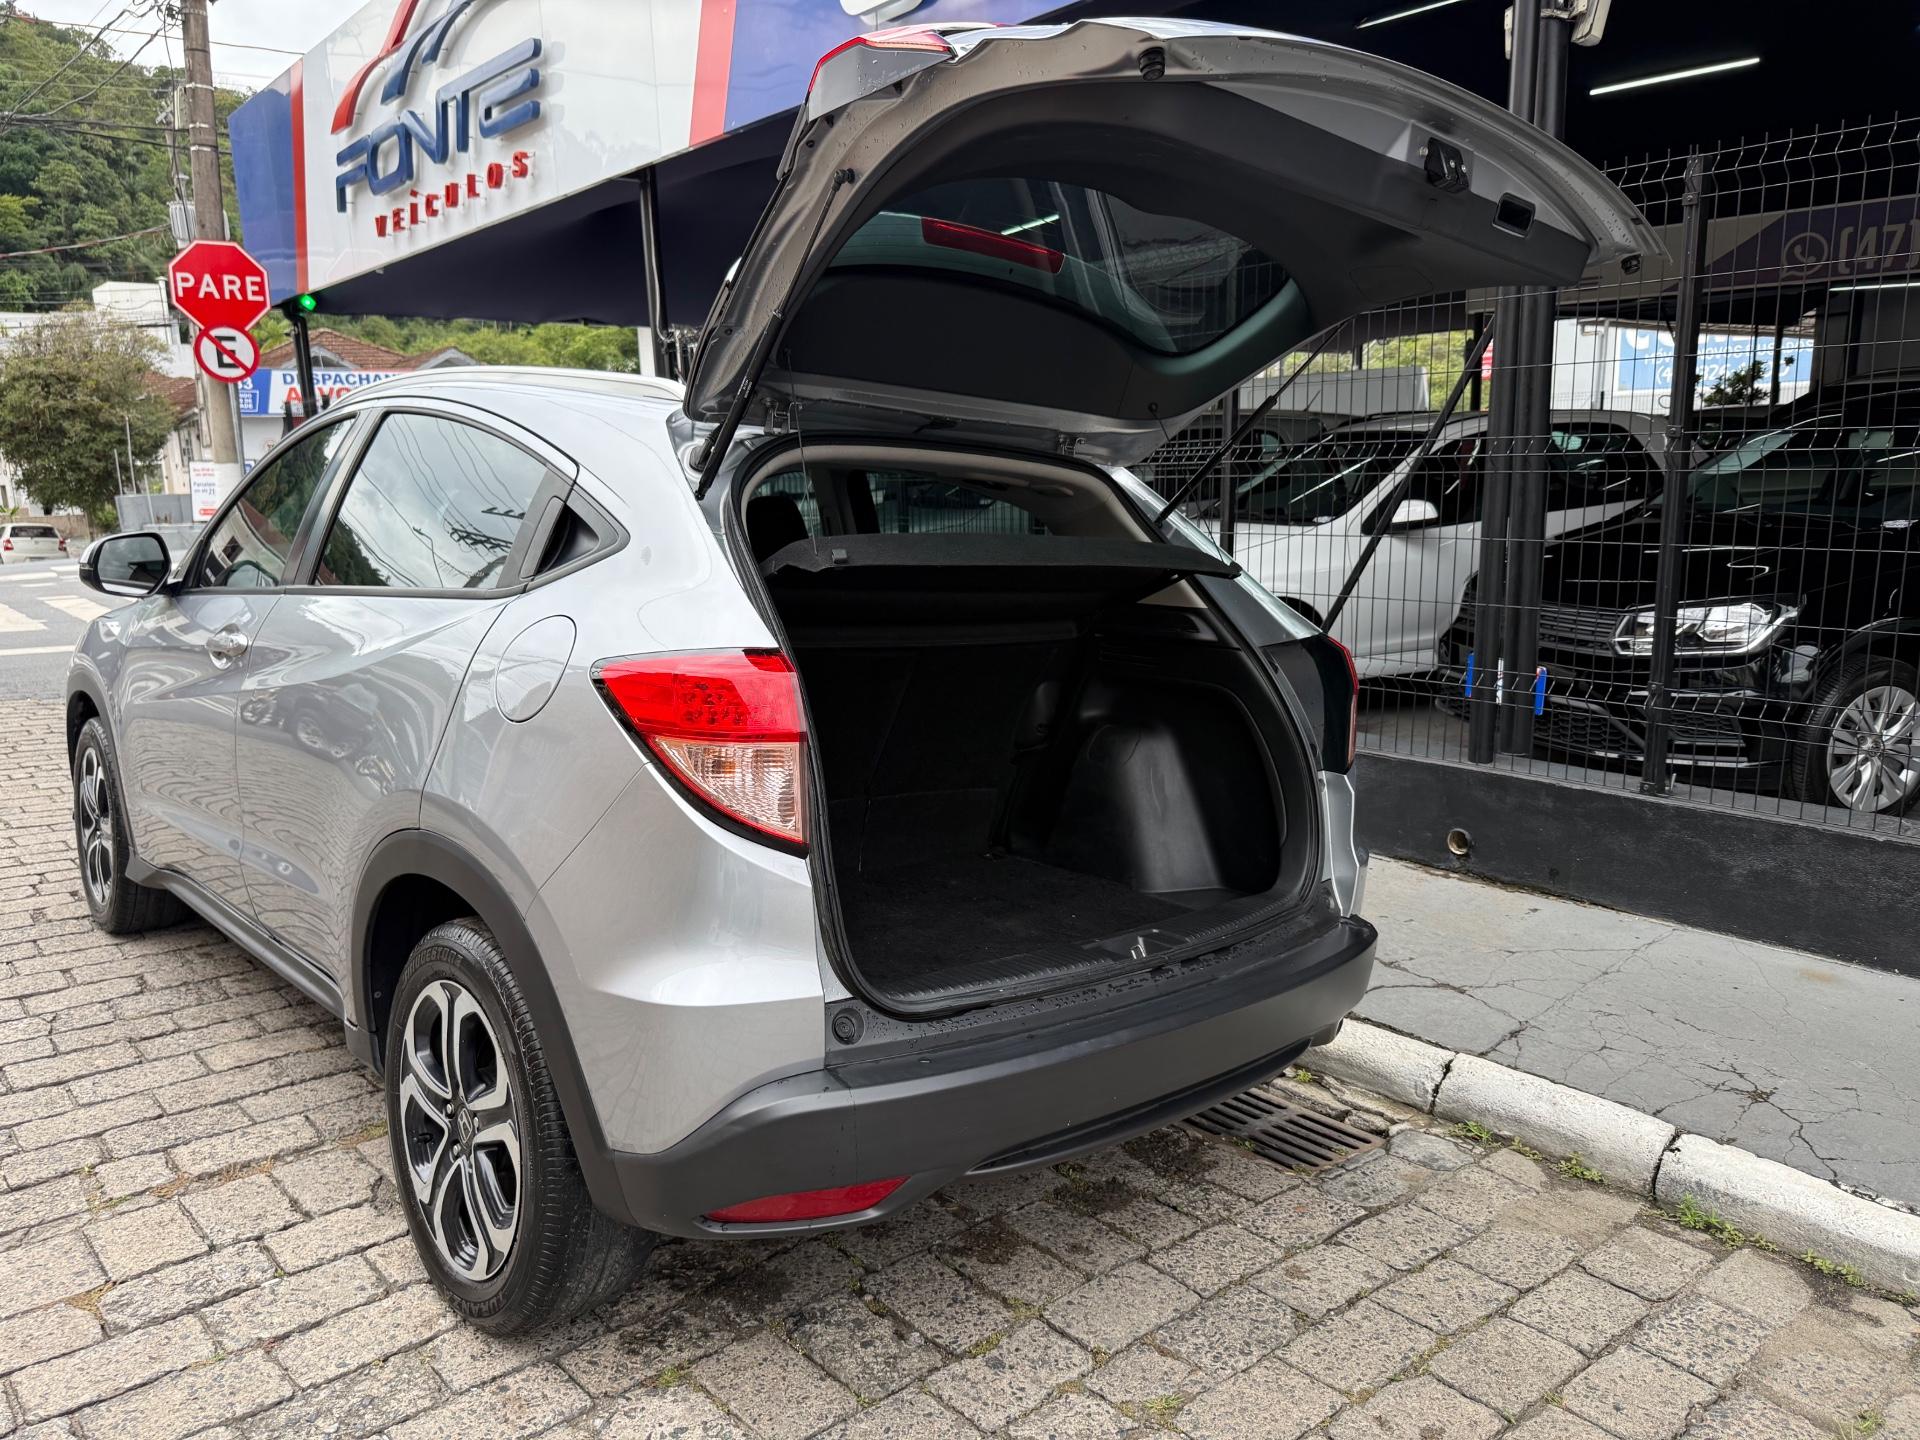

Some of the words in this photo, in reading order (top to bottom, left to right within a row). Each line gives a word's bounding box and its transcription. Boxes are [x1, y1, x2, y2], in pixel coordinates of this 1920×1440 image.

[336, 37, 542, 213] FONTE
[175, 272, 264, 301] PARE
[215, 335, 240, 368] E
